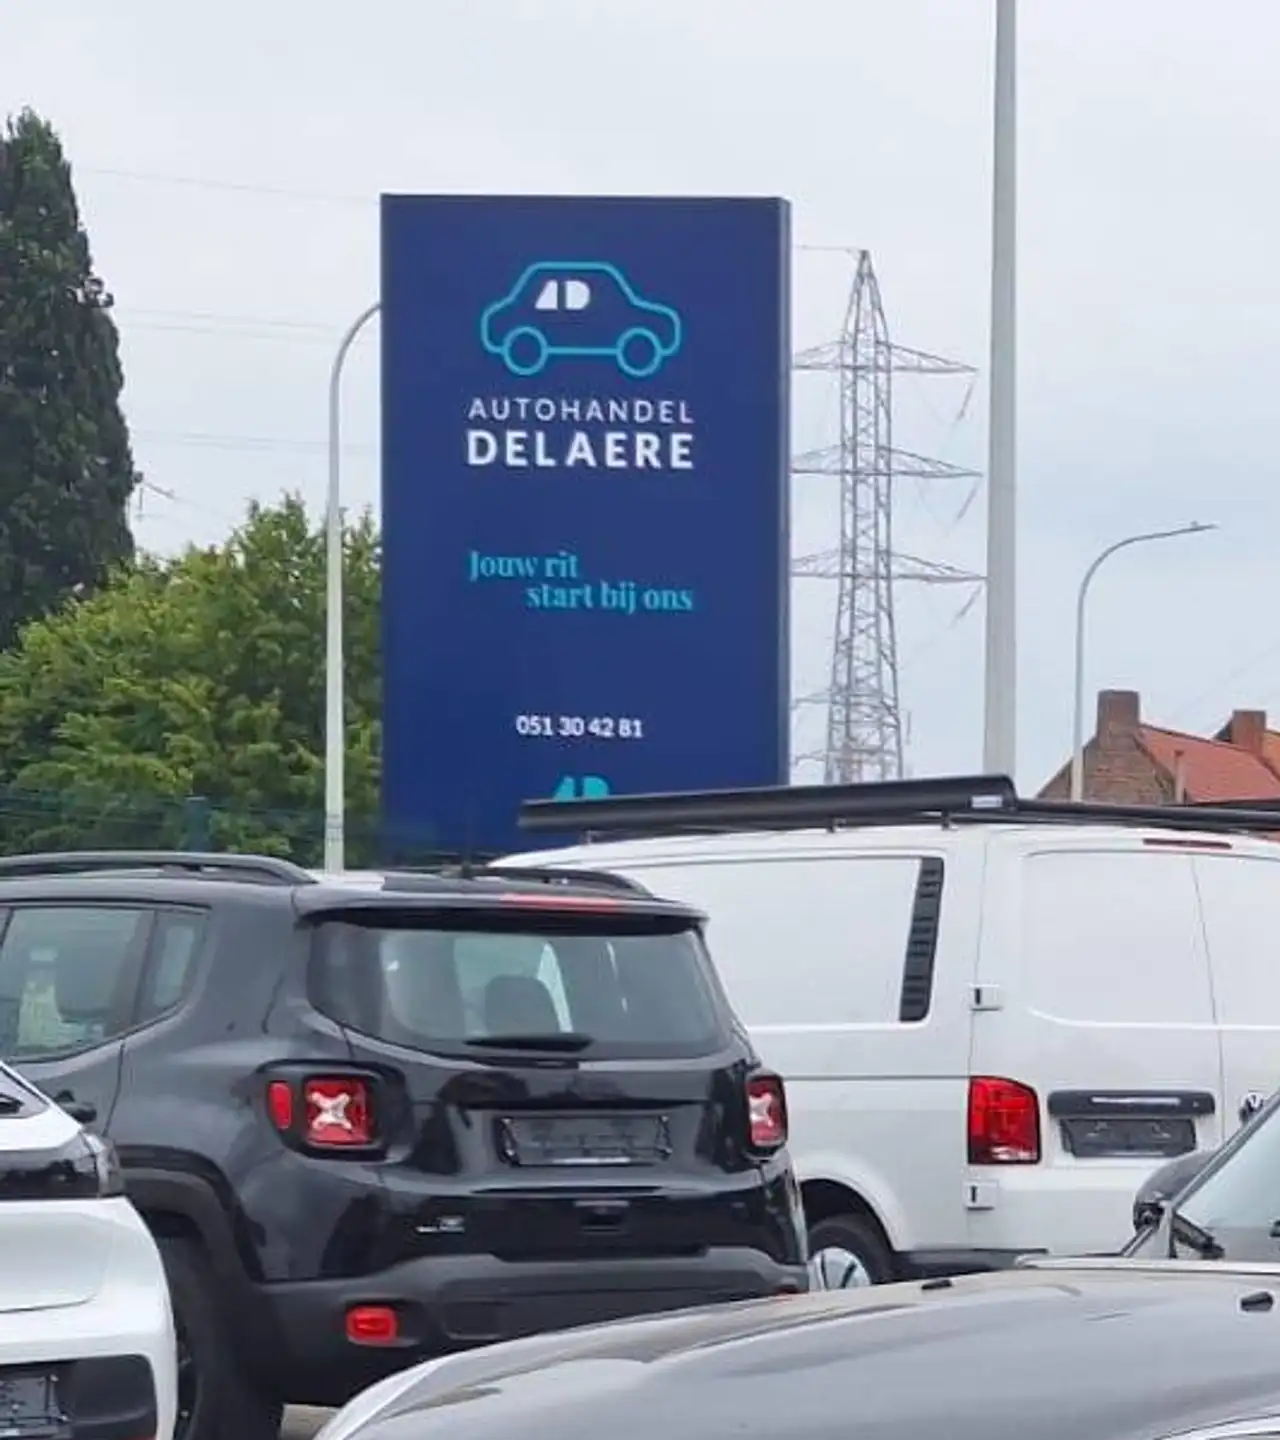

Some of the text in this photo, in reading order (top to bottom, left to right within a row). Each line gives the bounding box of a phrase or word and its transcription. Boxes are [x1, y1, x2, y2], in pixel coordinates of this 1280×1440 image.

[467, 397, 695, 425] AUTOHANDEL
[466, 429, 694, 470] DELAERE
[469, 550, 578, 583] Jouw rit
[526, 581, 693, 615] start bij ons
[515, 714, 643, 739] 051 30 42 81
